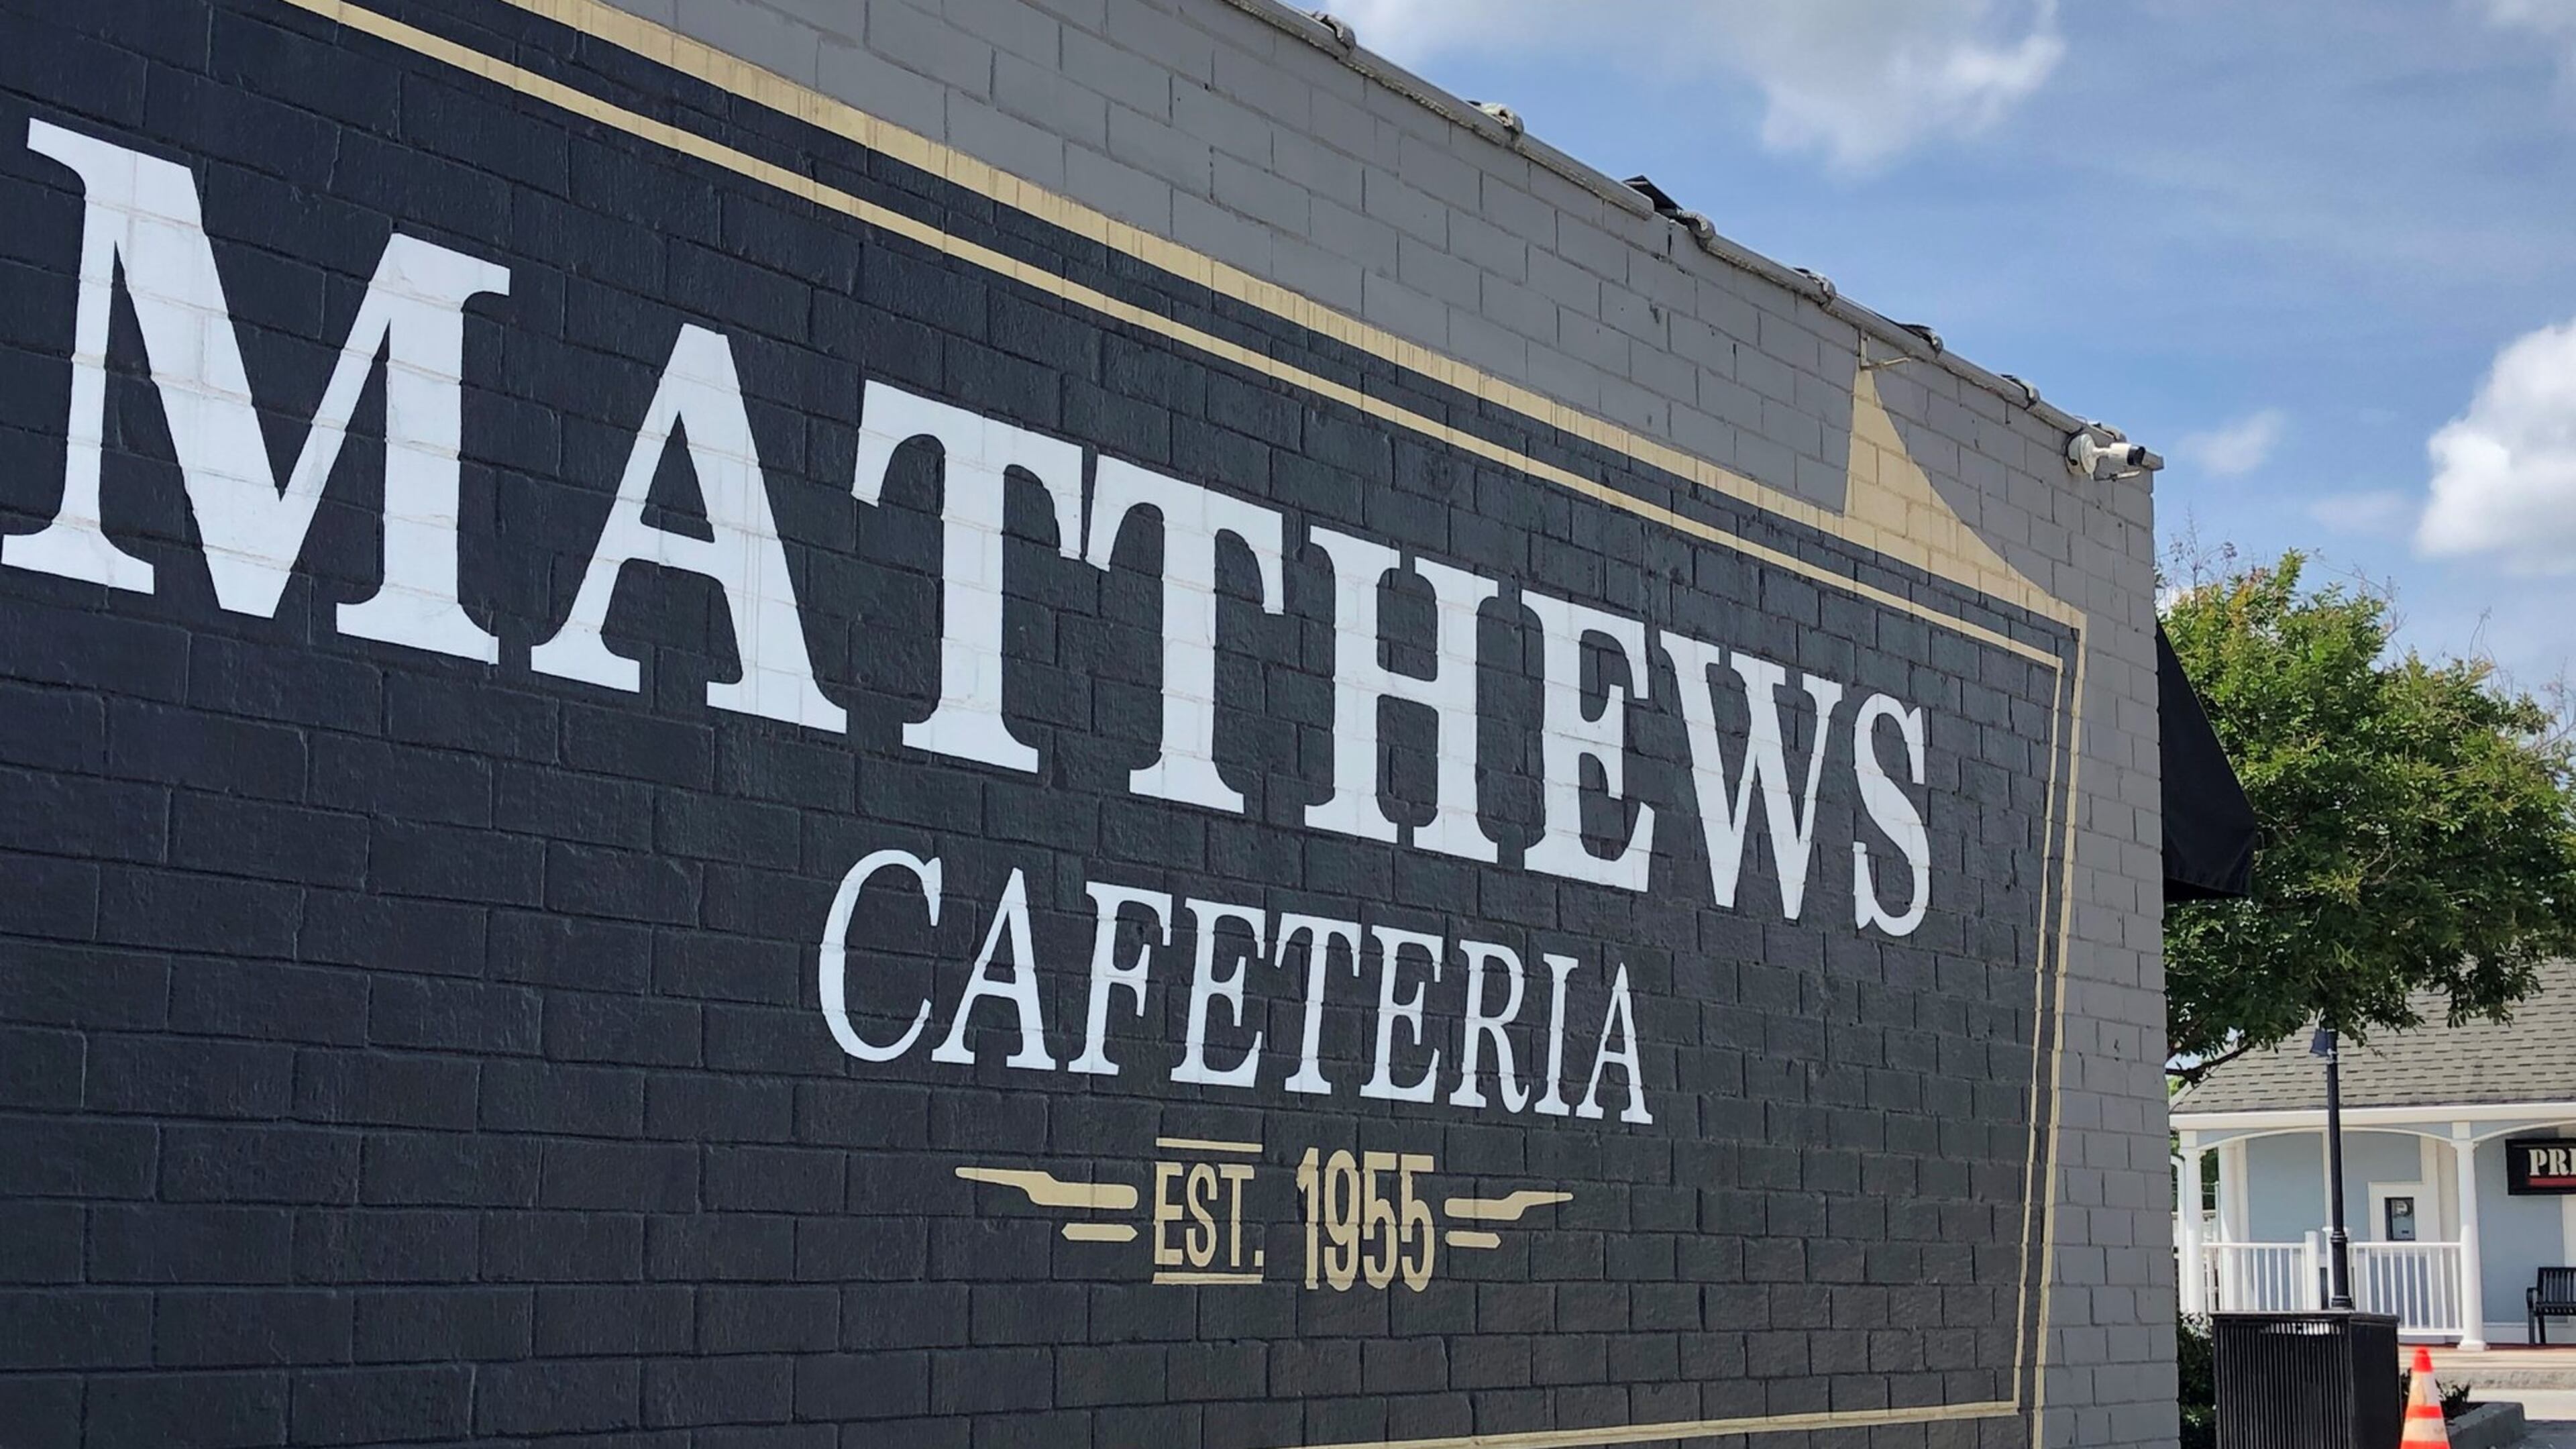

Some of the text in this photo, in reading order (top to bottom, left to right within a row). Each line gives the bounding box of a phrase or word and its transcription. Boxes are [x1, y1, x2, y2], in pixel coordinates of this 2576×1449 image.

[1, 118, 1931, 937] MATTHEWS
[818, 849, 1654, 1126] CAFETERIA
[1153, 1147, 1436, 1292] EST. 1955
